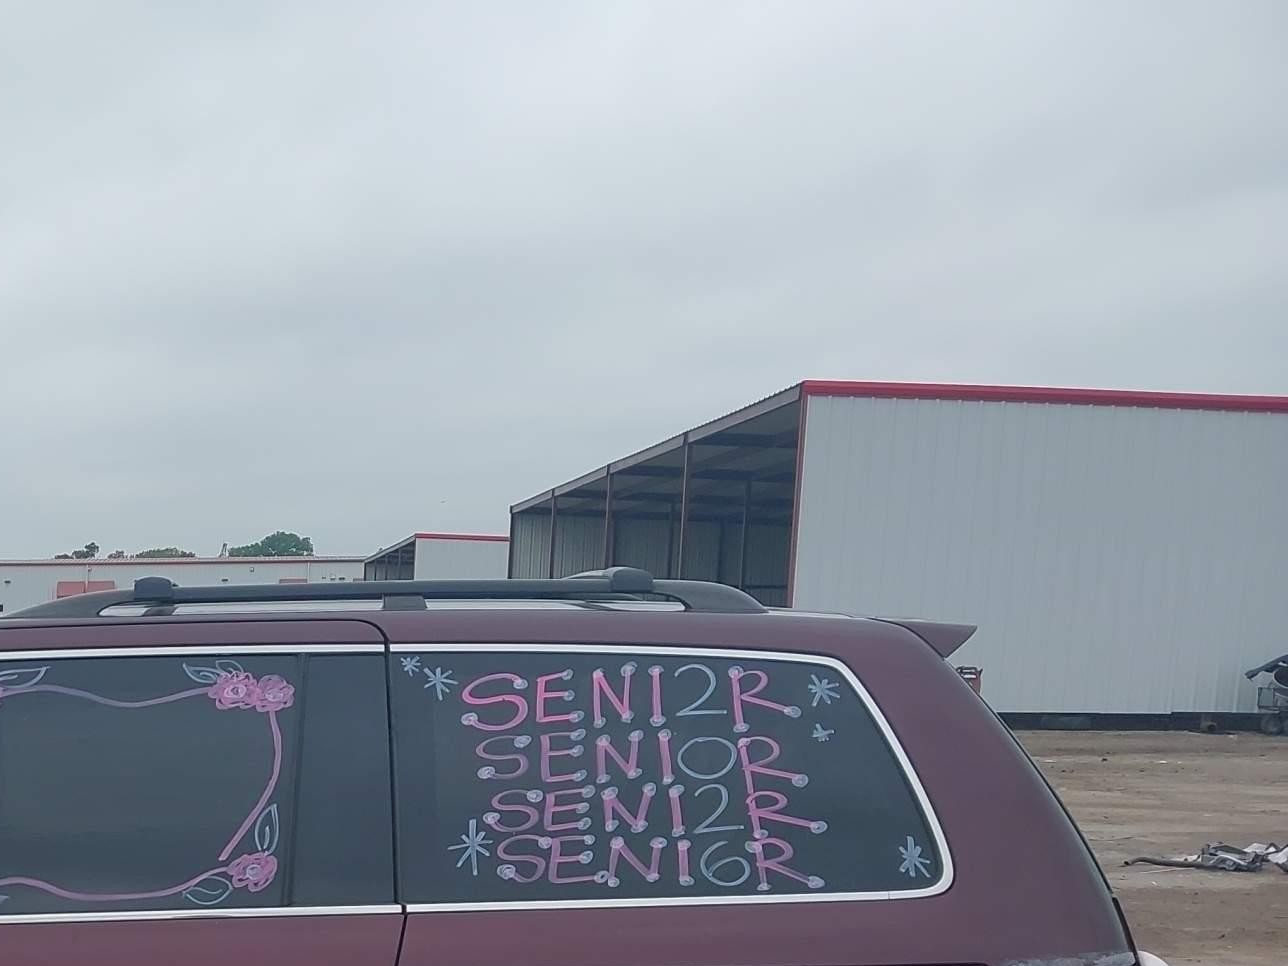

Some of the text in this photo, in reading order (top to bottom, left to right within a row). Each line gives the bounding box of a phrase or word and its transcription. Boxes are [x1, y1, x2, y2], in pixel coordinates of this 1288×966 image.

[461, 662, 802, 732] SENI2R
[482, 783, 828, 839] SENI2R
[496, 833, 826, 892] SENI6R
